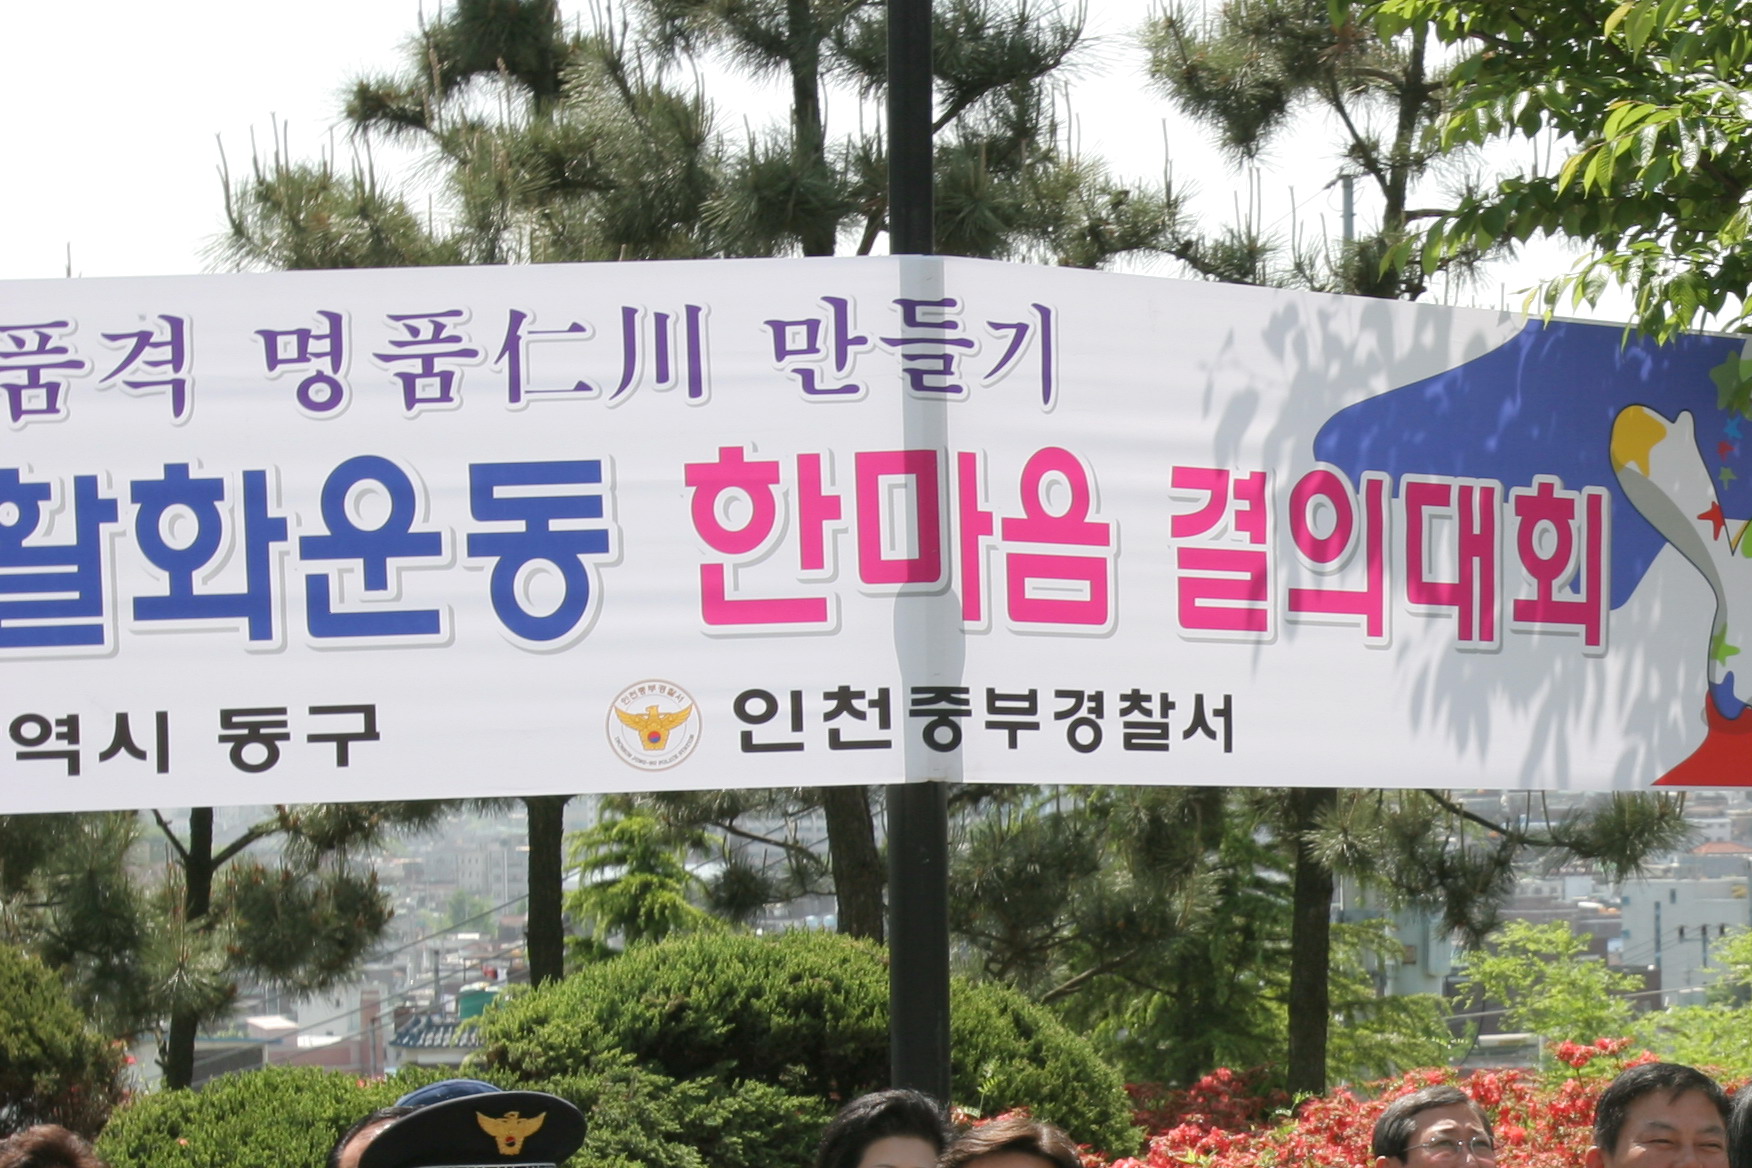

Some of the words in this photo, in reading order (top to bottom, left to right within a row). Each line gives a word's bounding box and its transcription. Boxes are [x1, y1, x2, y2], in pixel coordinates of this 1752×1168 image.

[0, 315, 187, 421] 품격
[766, 296, 1056, 403] 만들기
[685, 446, 1110, 625] 한마음
[1170, 466, 1605, 646] 결의대회
[9, 711, 170, 776] 역시
[218, 704, 380, 773] 동구
[733, 685, 1233, 755] 인천중부경찰서
